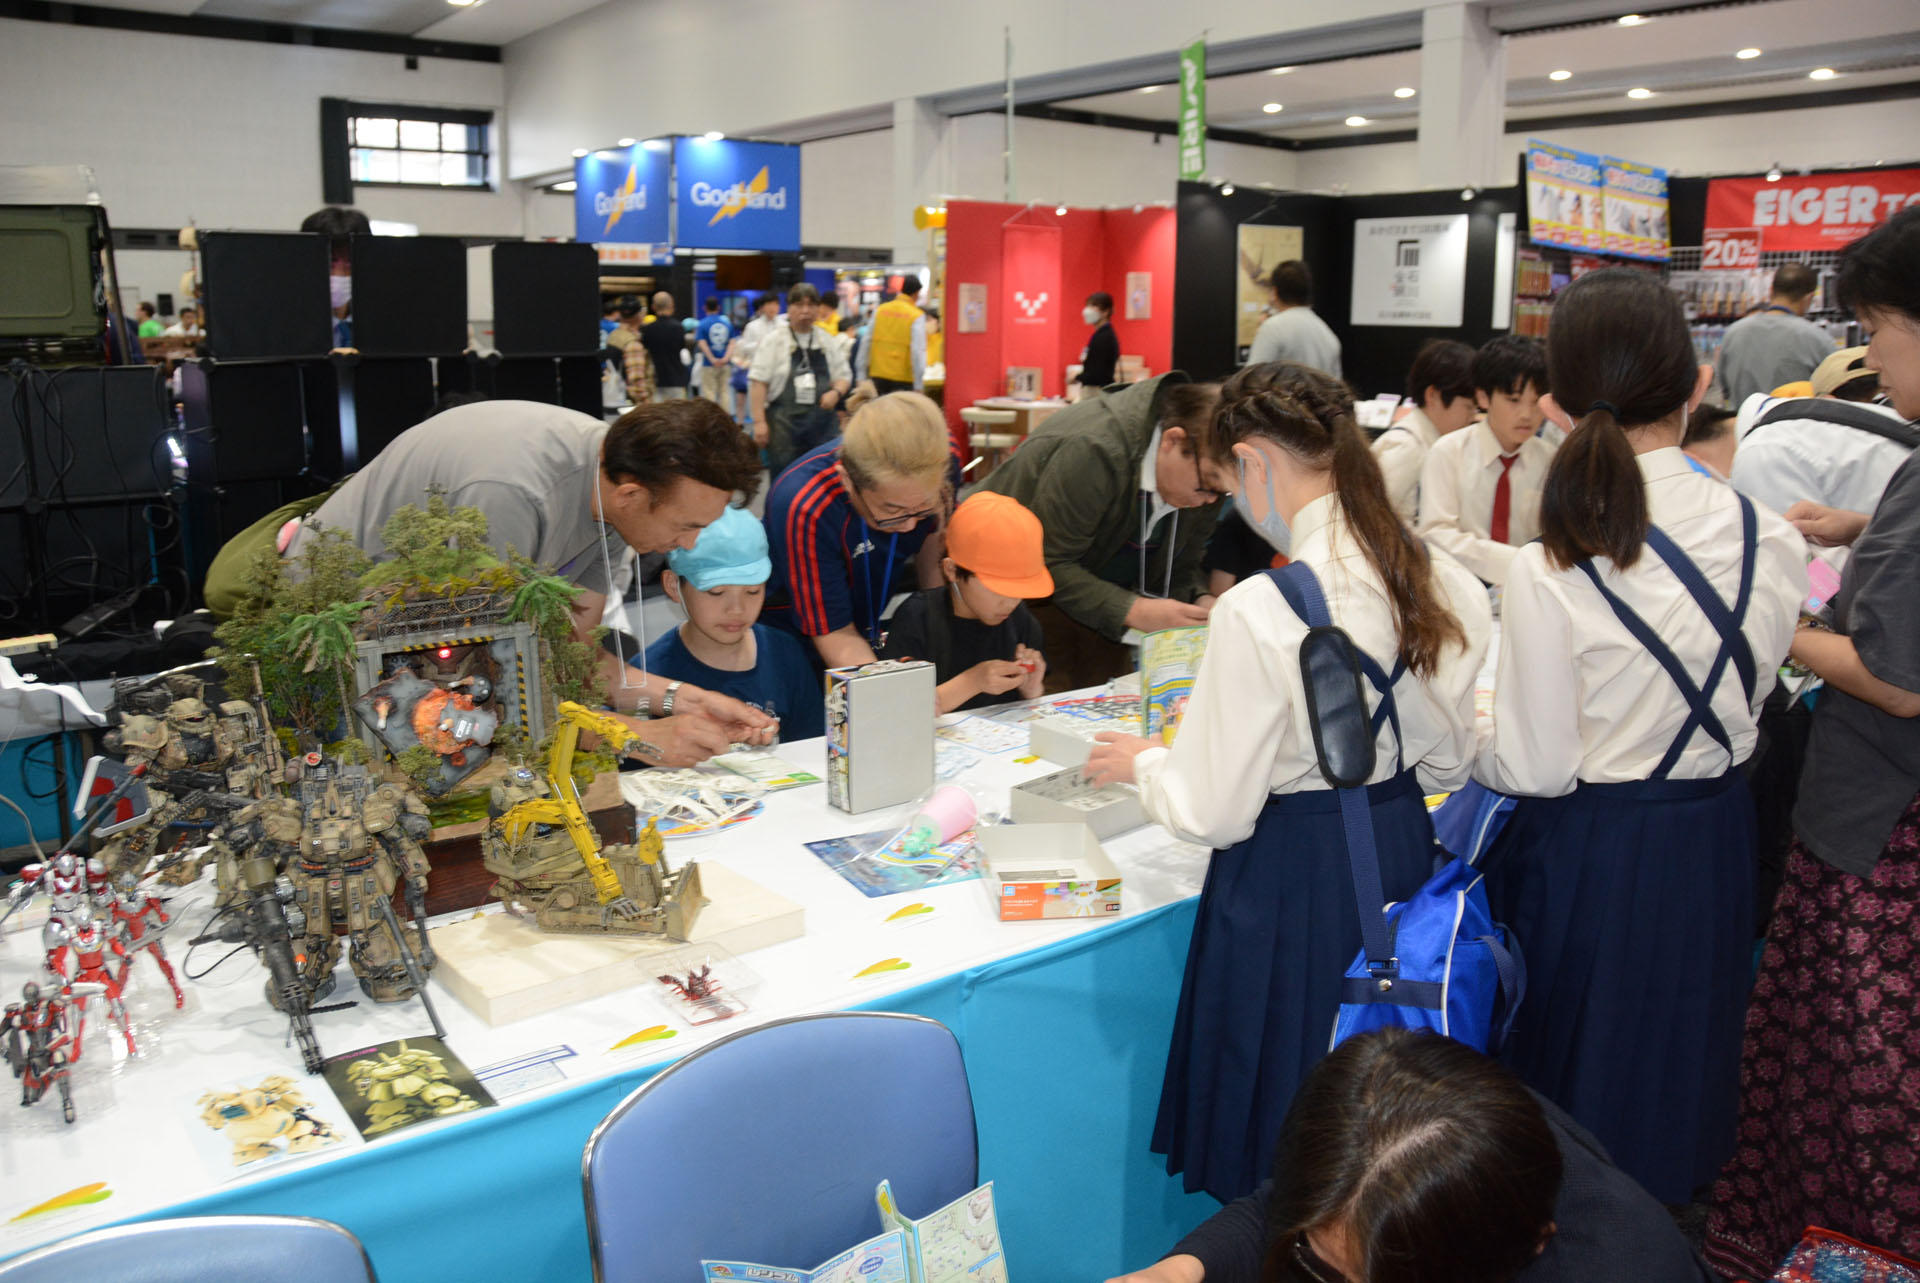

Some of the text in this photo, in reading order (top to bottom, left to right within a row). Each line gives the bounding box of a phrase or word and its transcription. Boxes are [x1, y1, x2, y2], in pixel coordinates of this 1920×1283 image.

[691, 182, 786, 210] GodHand
[1753, 186, 1879, 226] EIGER
[1703, 238, 1758, 267] 20%
